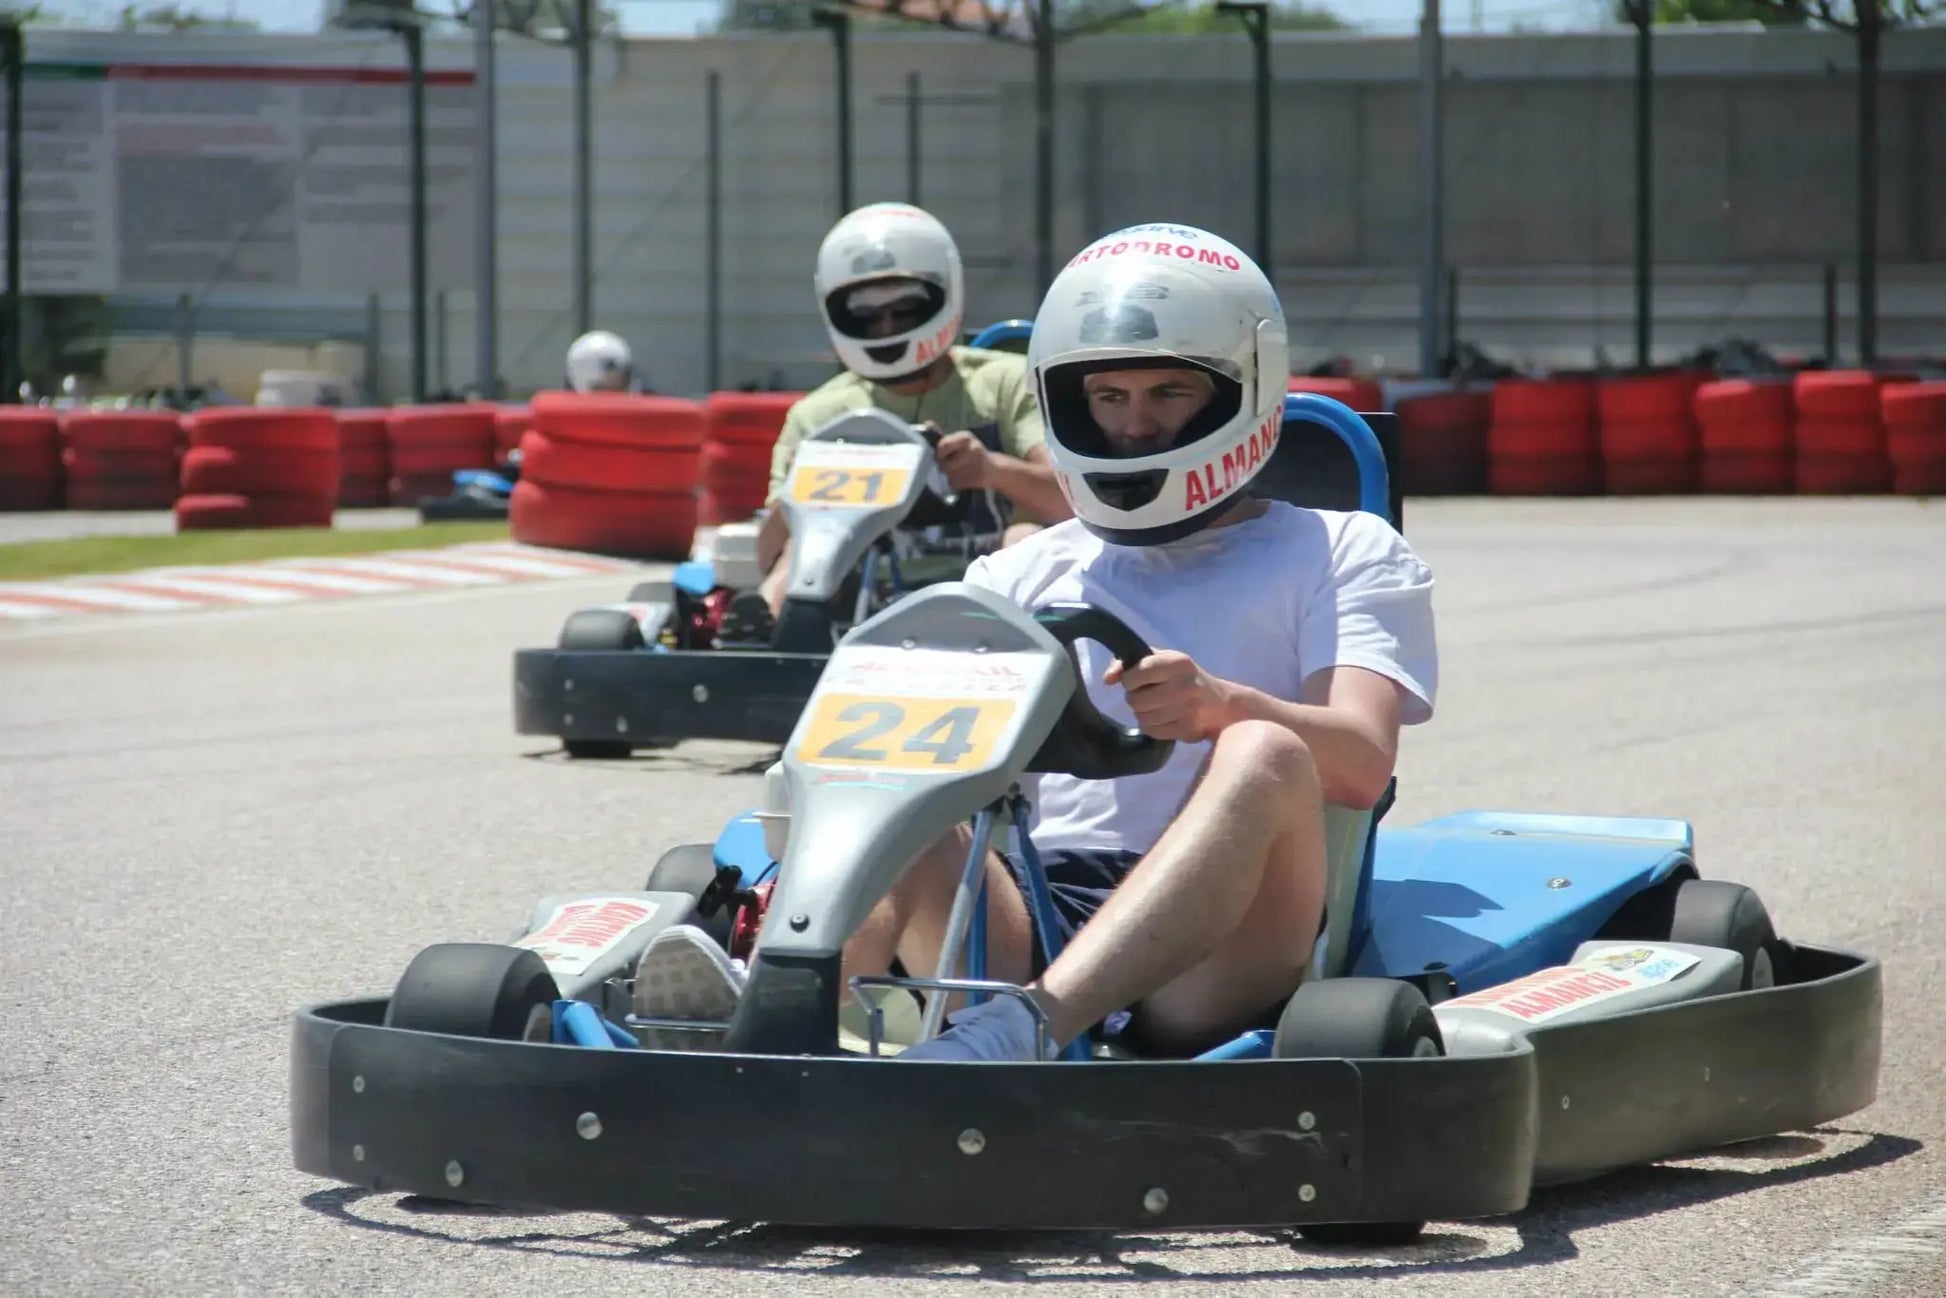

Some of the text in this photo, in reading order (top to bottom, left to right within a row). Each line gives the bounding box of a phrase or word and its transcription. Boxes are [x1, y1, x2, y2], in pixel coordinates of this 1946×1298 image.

[809, 469, 885, 502] 21
[817, 701, 982, 765] 24
[1498, 971, 1633, 1019] ALMANCIL
